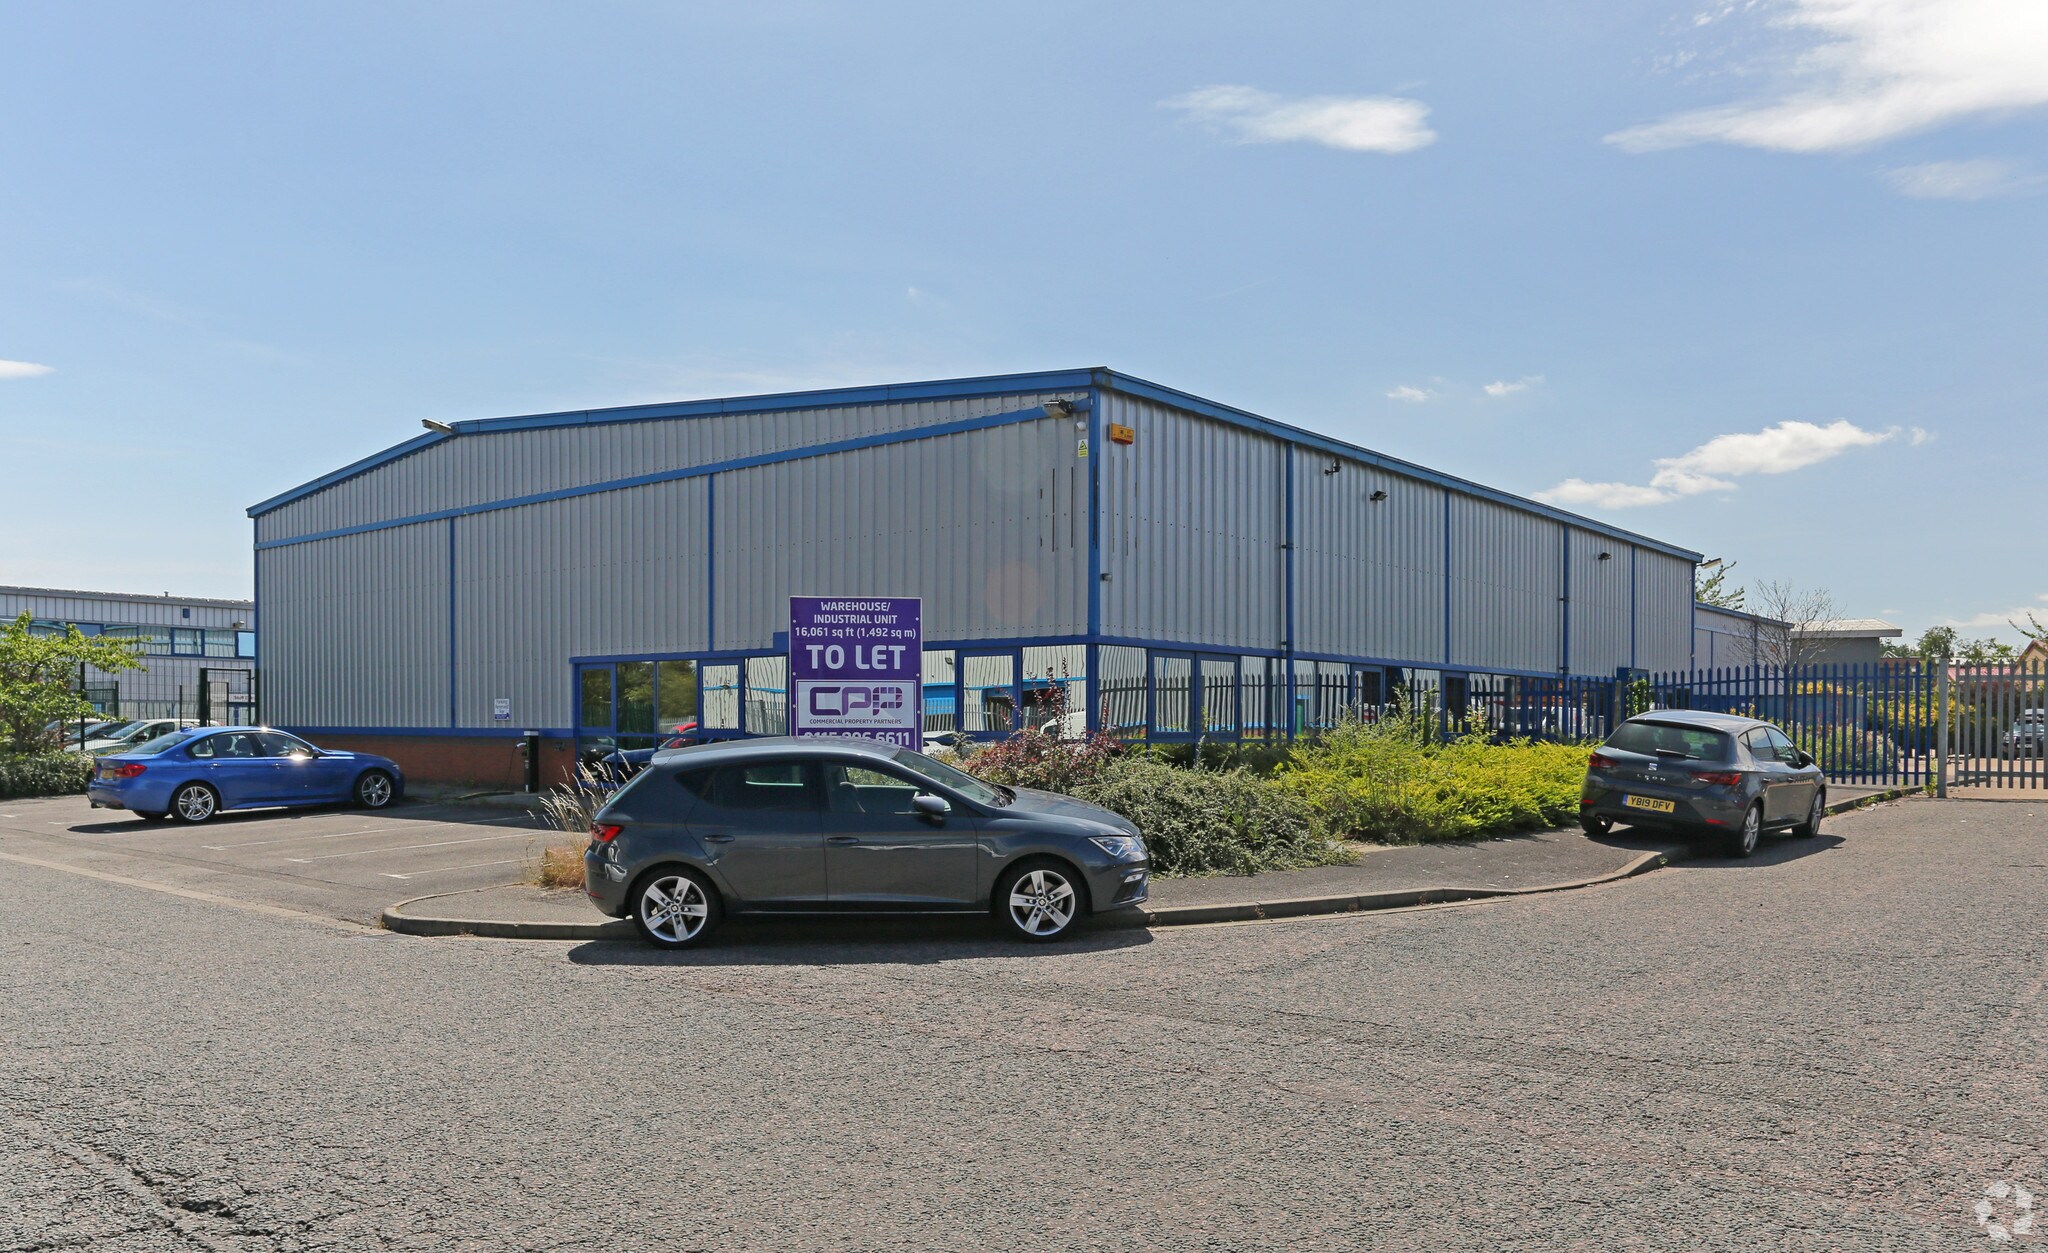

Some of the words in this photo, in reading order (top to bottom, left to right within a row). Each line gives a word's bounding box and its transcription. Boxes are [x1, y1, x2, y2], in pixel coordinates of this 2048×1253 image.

[820, 601, 891, 612] WAREHOUSE/
[814, 614, 872, 624] INDUSTRIAL
[874, 614, 898, 624] UNIT
[795, 627, 829, 638] 16,061
[831, 629, 843, 639] sq
[845, 627, 854, 637] ft
[856, 627, 888, 639] (1,492
[890, 629, 902, 639] sq
[904, 628, 917, 640] m)
[805, 644, 845, 670] TO
[855, 645, 906, 670] LET
[809, 686, 903, 716] CPP
[1630, 796, 1651, 807] YB19
[1652, 800, 1671, 810] DFV
